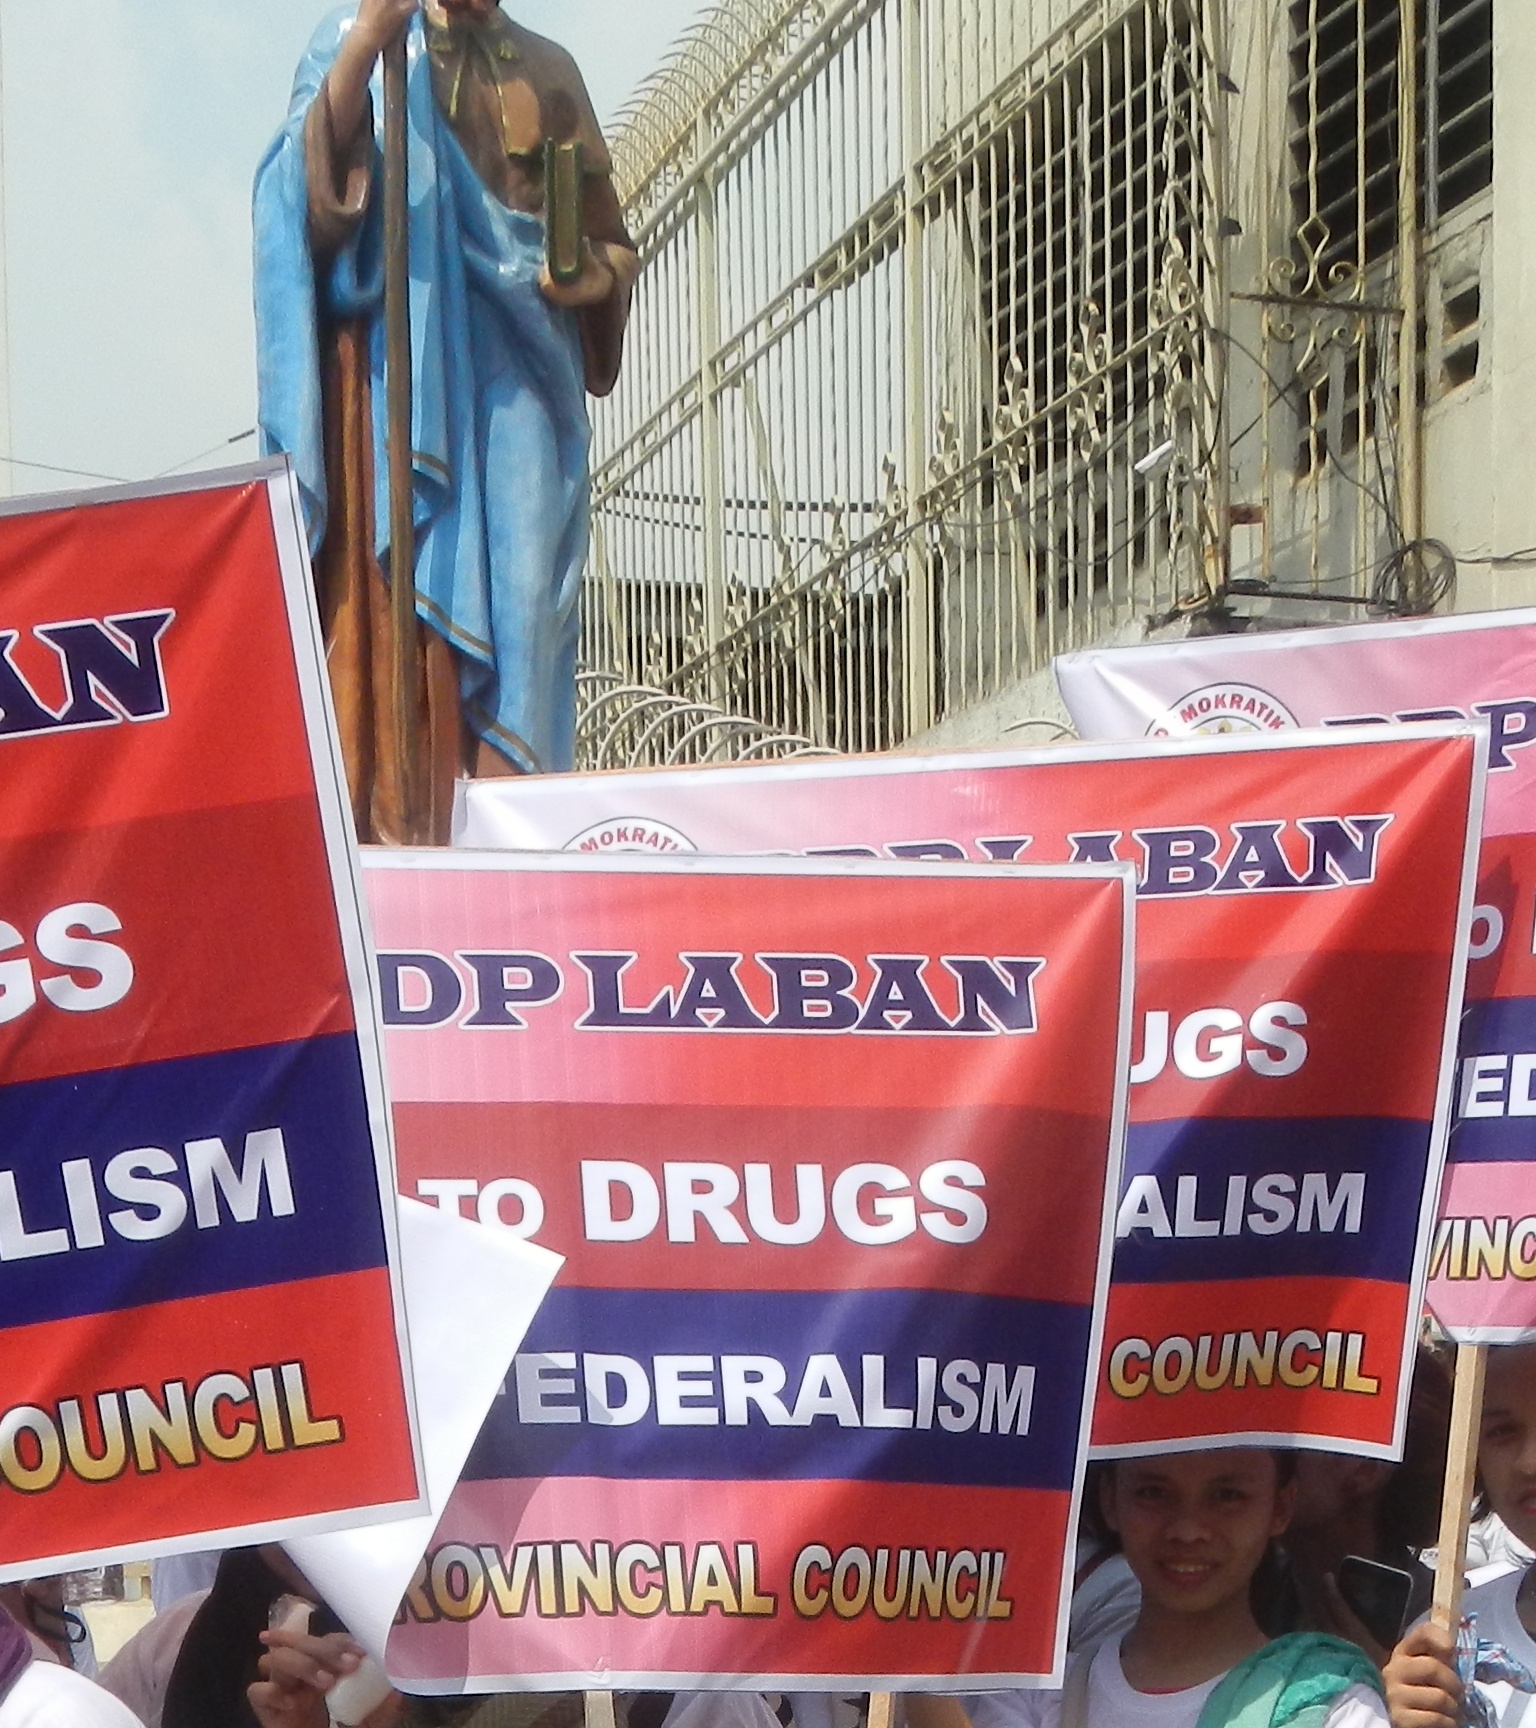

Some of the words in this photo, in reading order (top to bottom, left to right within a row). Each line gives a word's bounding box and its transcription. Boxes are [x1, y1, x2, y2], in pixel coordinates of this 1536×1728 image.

[569, 950, 1047, 1036] LABAN
[417, 1177, 544, 1241] TO
[580, 1158, 988, 1244] DRUGS
[499, 1352, 1037, 1436] EDERALISM
[1107, 1329, 1381, 1399] COUNCIL
[792, 1542, 1013, 1621] COUNCIL
